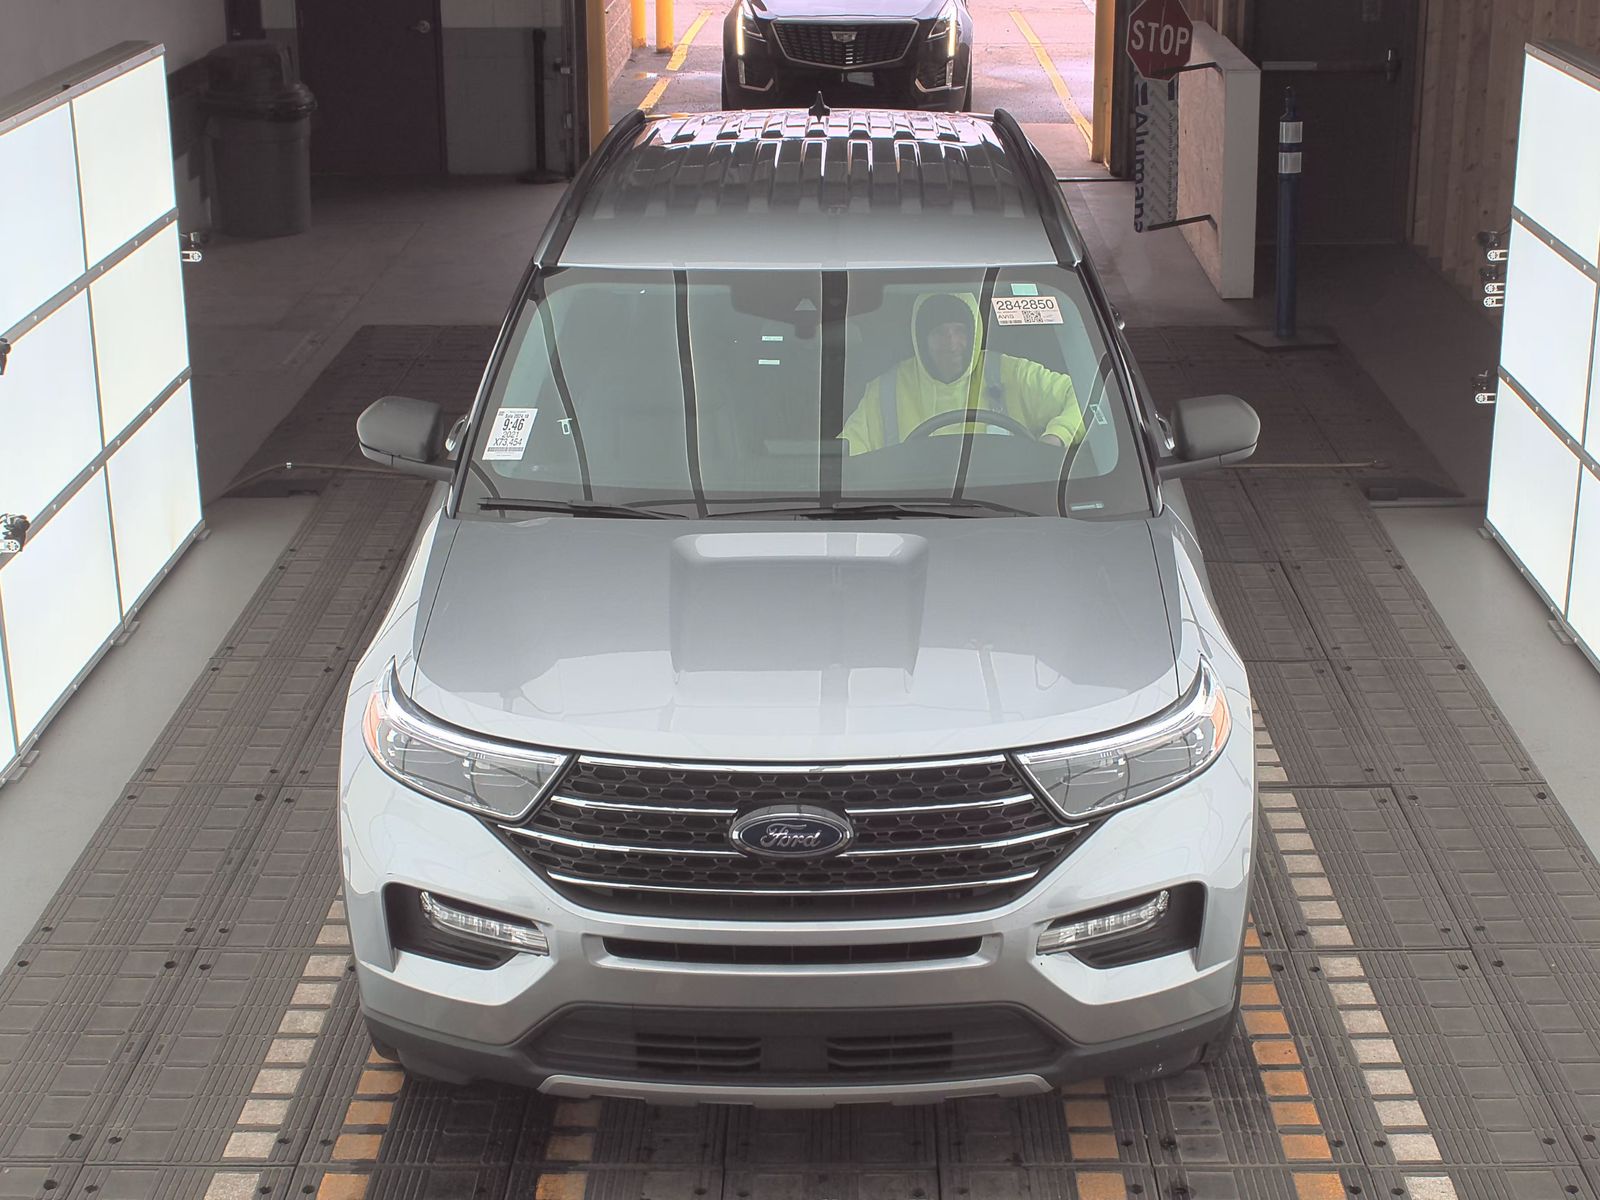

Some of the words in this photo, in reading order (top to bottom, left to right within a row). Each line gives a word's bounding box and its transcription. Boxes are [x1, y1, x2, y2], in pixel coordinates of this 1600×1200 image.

[1131, 19, 1190, 56] STOP
[997, 300, 1054, 310] 2842850
[502, 418, 525, 430] 9:46
[760, 822, 822, 848] Ford
